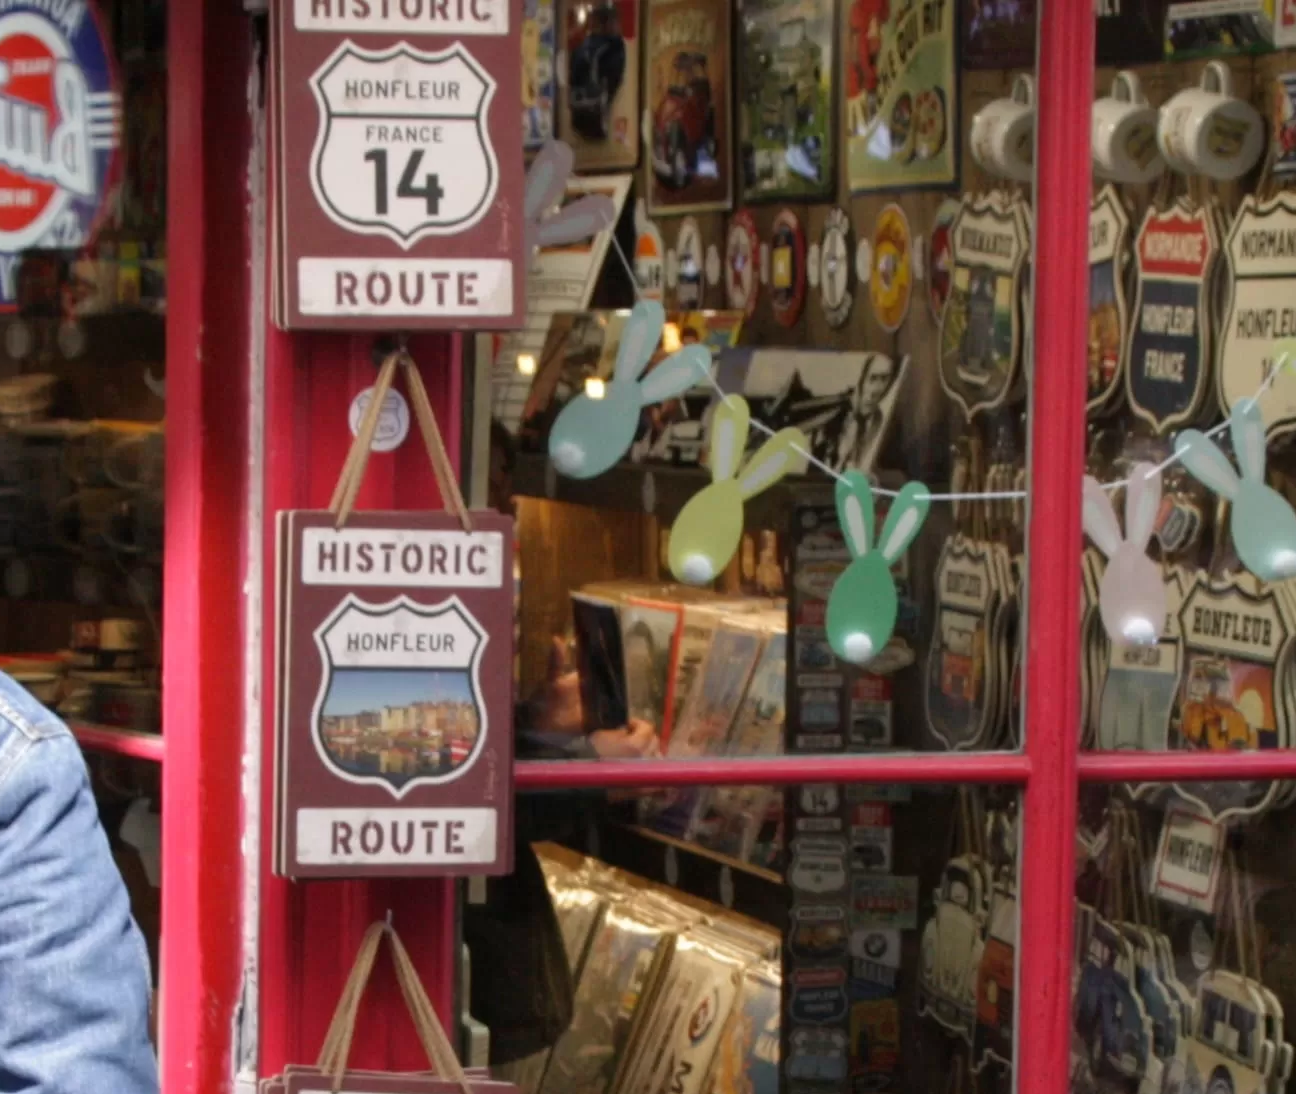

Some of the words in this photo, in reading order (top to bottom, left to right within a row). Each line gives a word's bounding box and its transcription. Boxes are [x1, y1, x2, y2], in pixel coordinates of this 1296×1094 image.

[310, 0, 493, 22] HISTORIC
[345, 80, 461, 101] HONFLEUR
[365, 125, 444, 144] FRANCE
[364, 148, 445, 216] 14
[335, 271, 480, 307] ROUTE
[317, 541, 490, 576] HISTORIC
[347, 632, 456, 653] HONFLEUR
[1193, 607, 1272, 646] HONFLEUR
[331, 820, 466, 856] ROUTE
